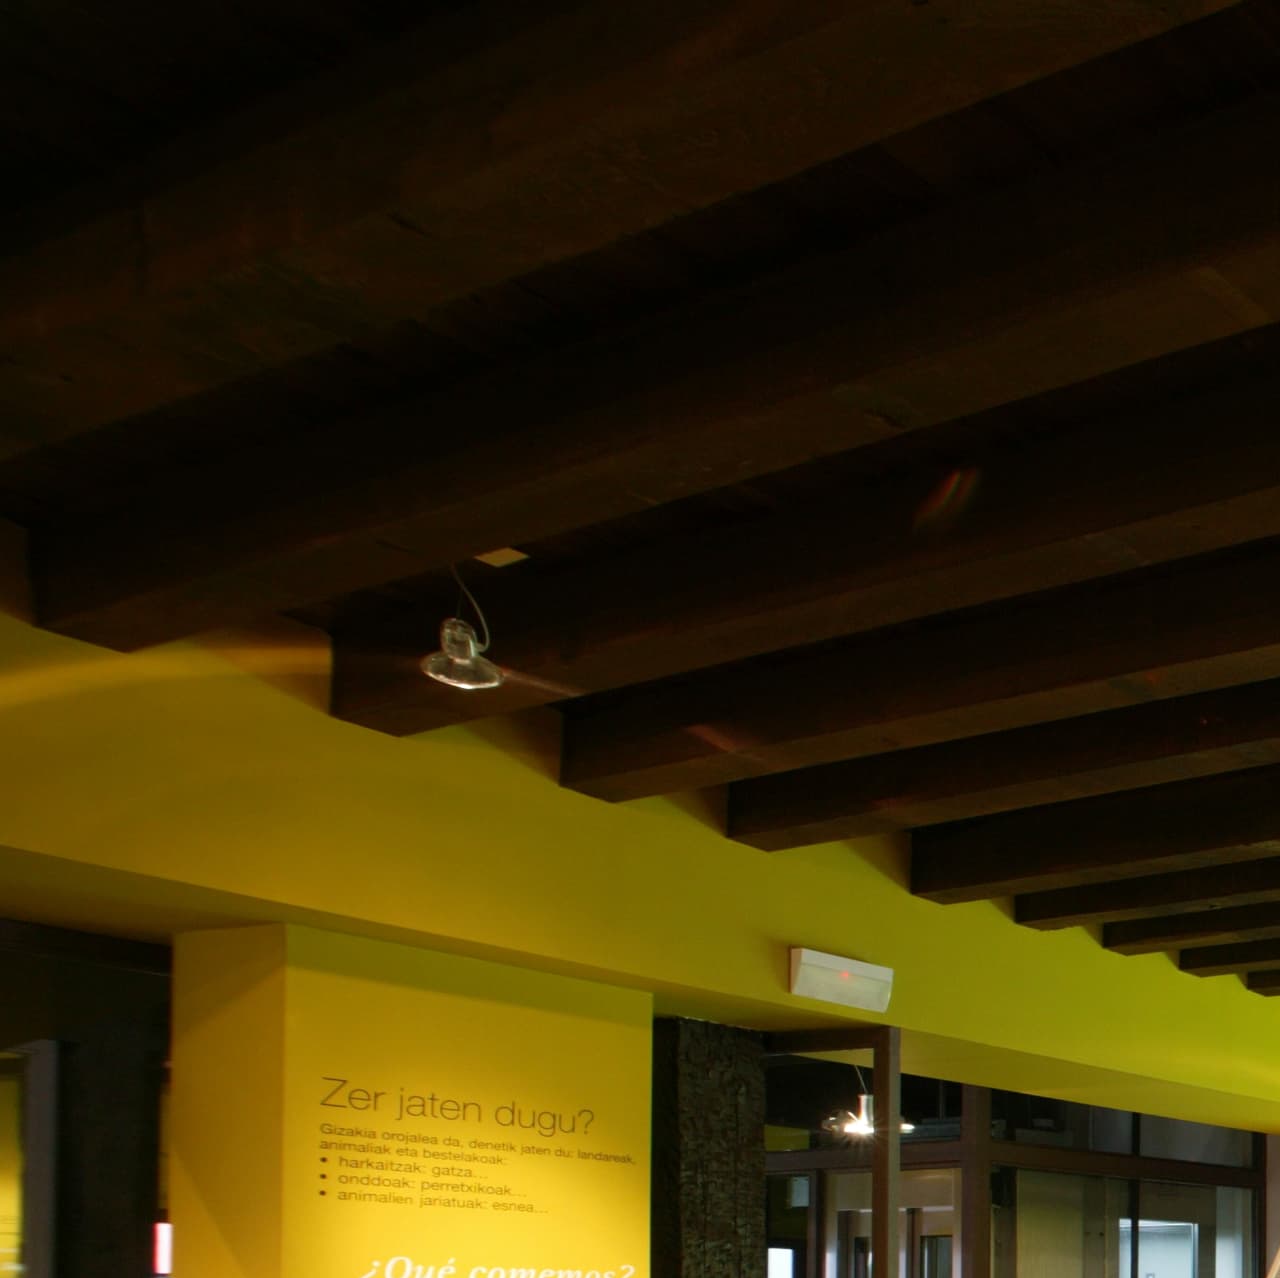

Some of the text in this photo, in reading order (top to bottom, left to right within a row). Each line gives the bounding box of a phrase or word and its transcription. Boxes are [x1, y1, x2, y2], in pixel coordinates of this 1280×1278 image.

[319, 1076, 595, 1138] Zer jaten dugu?
[319, 1122, 377, 1139] Gizakia
[381, 1130, 438, 1145] orojalea
[468, 1139, 517, 1153] denetik
[319, 1140, 391, 1155] animaliak
[395, 1147, 418, 1158] eta
[337, 1156, 427, 1174] harkaitzak:
[337, 1174, 416, 1189] onddoak:
